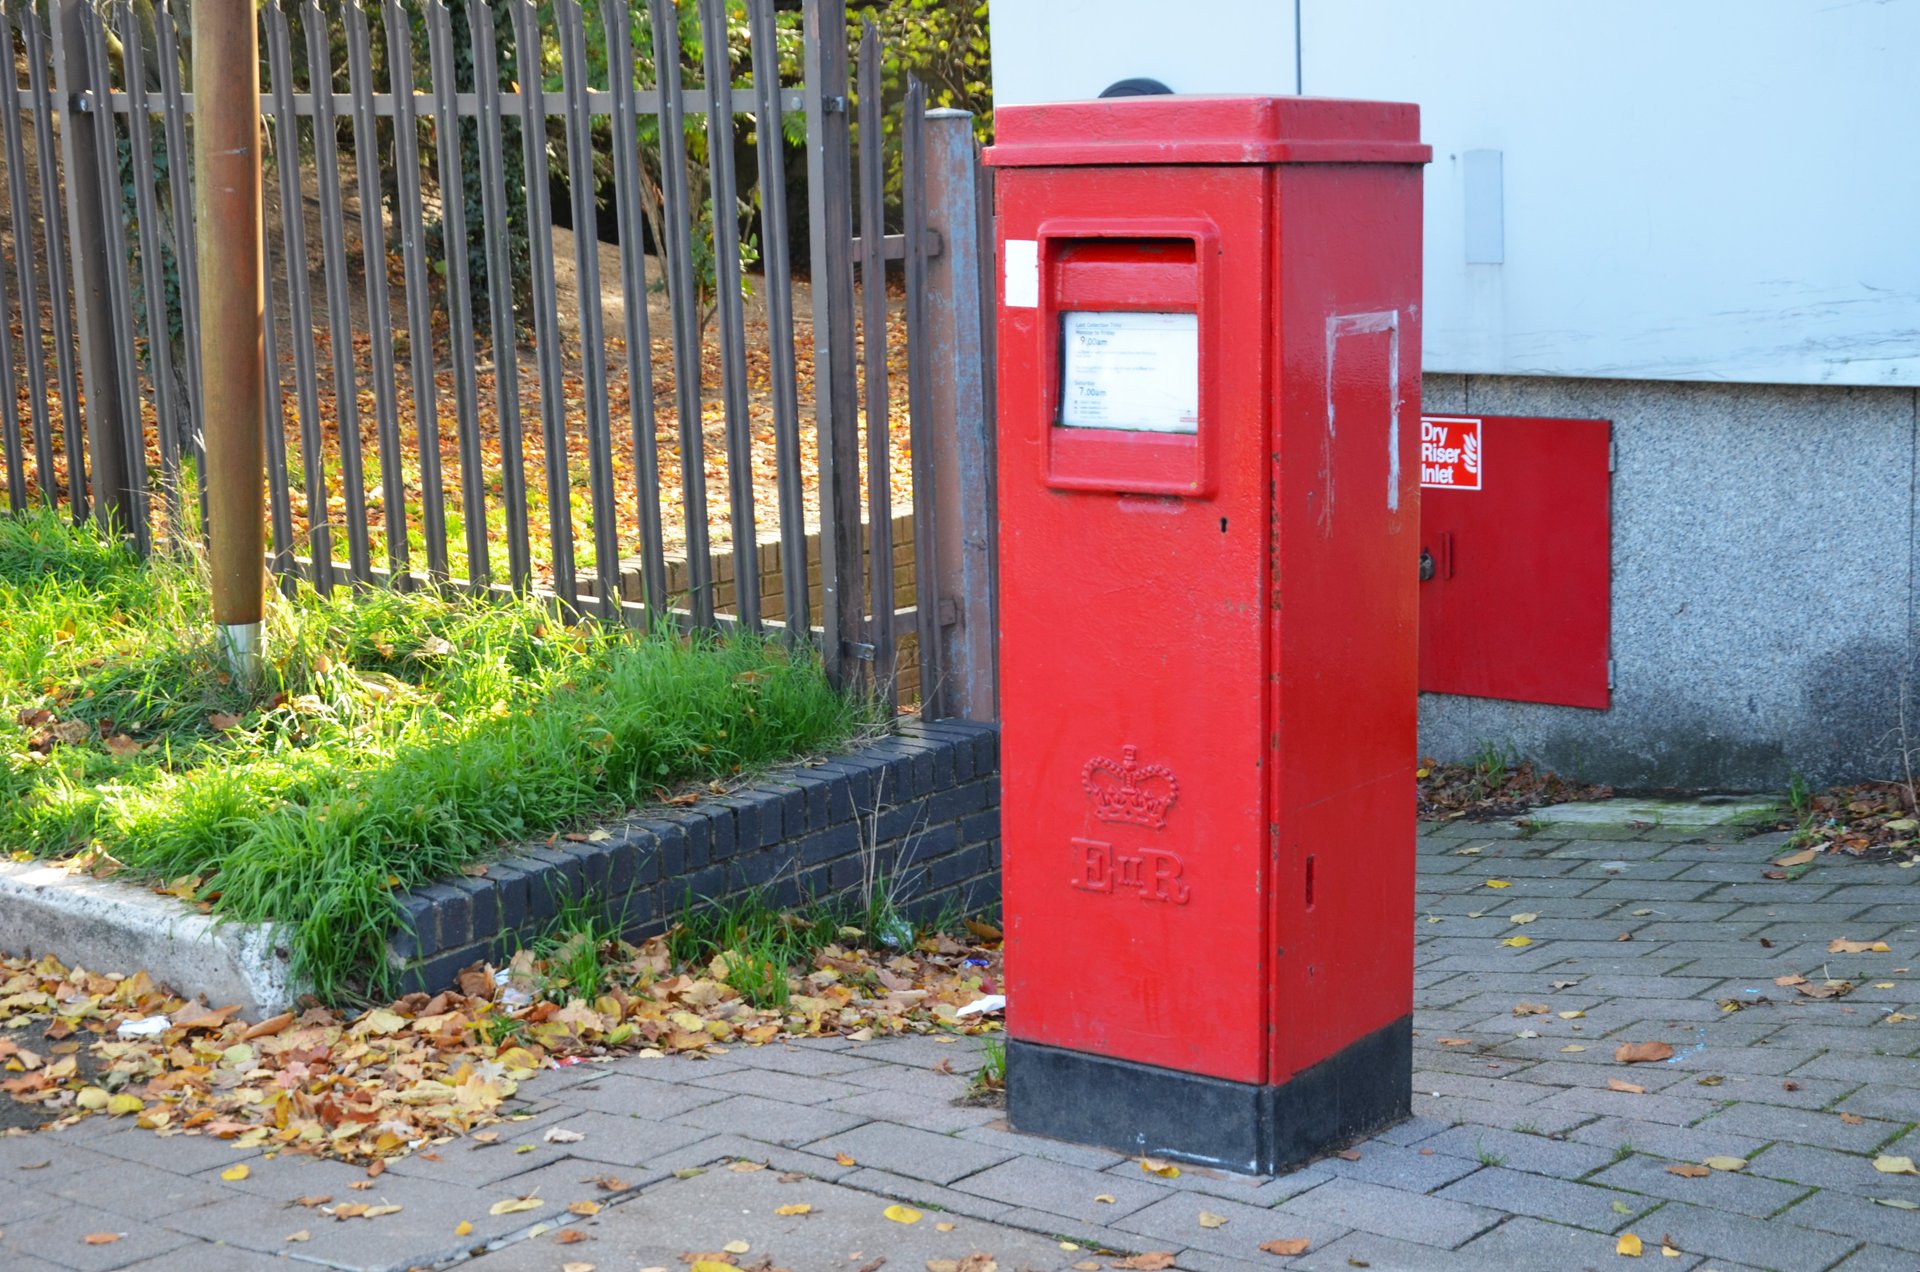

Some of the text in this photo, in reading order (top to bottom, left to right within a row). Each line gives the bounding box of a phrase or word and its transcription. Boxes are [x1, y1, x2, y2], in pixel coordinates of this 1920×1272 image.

[1421, 421, 1448, 447] Dry
[1421, 442, 1461, 463] Riser
[1421, 463, 1454, 484] Inlet
